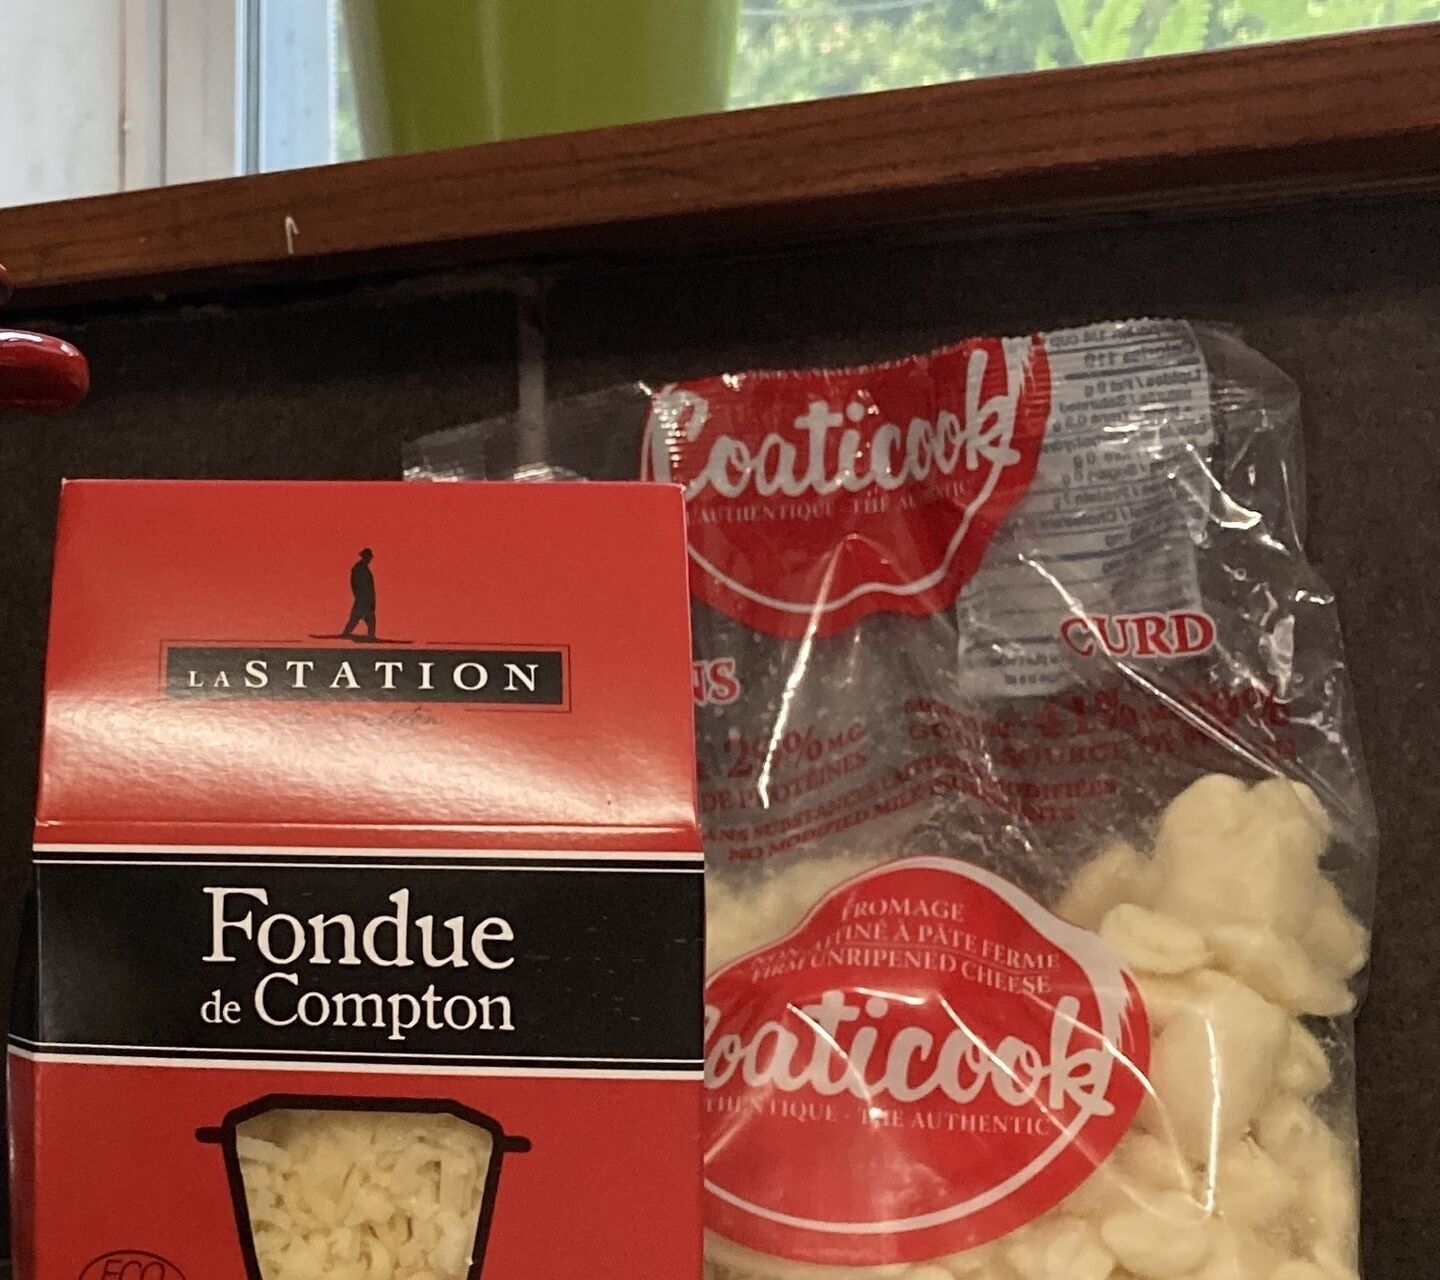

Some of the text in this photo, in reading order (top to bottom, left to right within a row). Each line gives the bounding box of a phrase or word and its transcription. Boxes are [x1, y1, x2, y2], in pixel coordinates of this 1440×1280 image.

[1060, 613, 1217, 656] CURD
[188, 660, 540, 692] LA STATION
[842, 895, 965, 922] FROMAGE
[202, 886, 515, 970] Fondue
[810, 947, 957, 972] UNRIPENED
[962, 960, 1052, 994] CHEESE
[983, 938, 1061, 969] FERME
[201, 972, 515, 1041] de Compton
[911, 1109, 1051, 1137] AUTHENTIC
